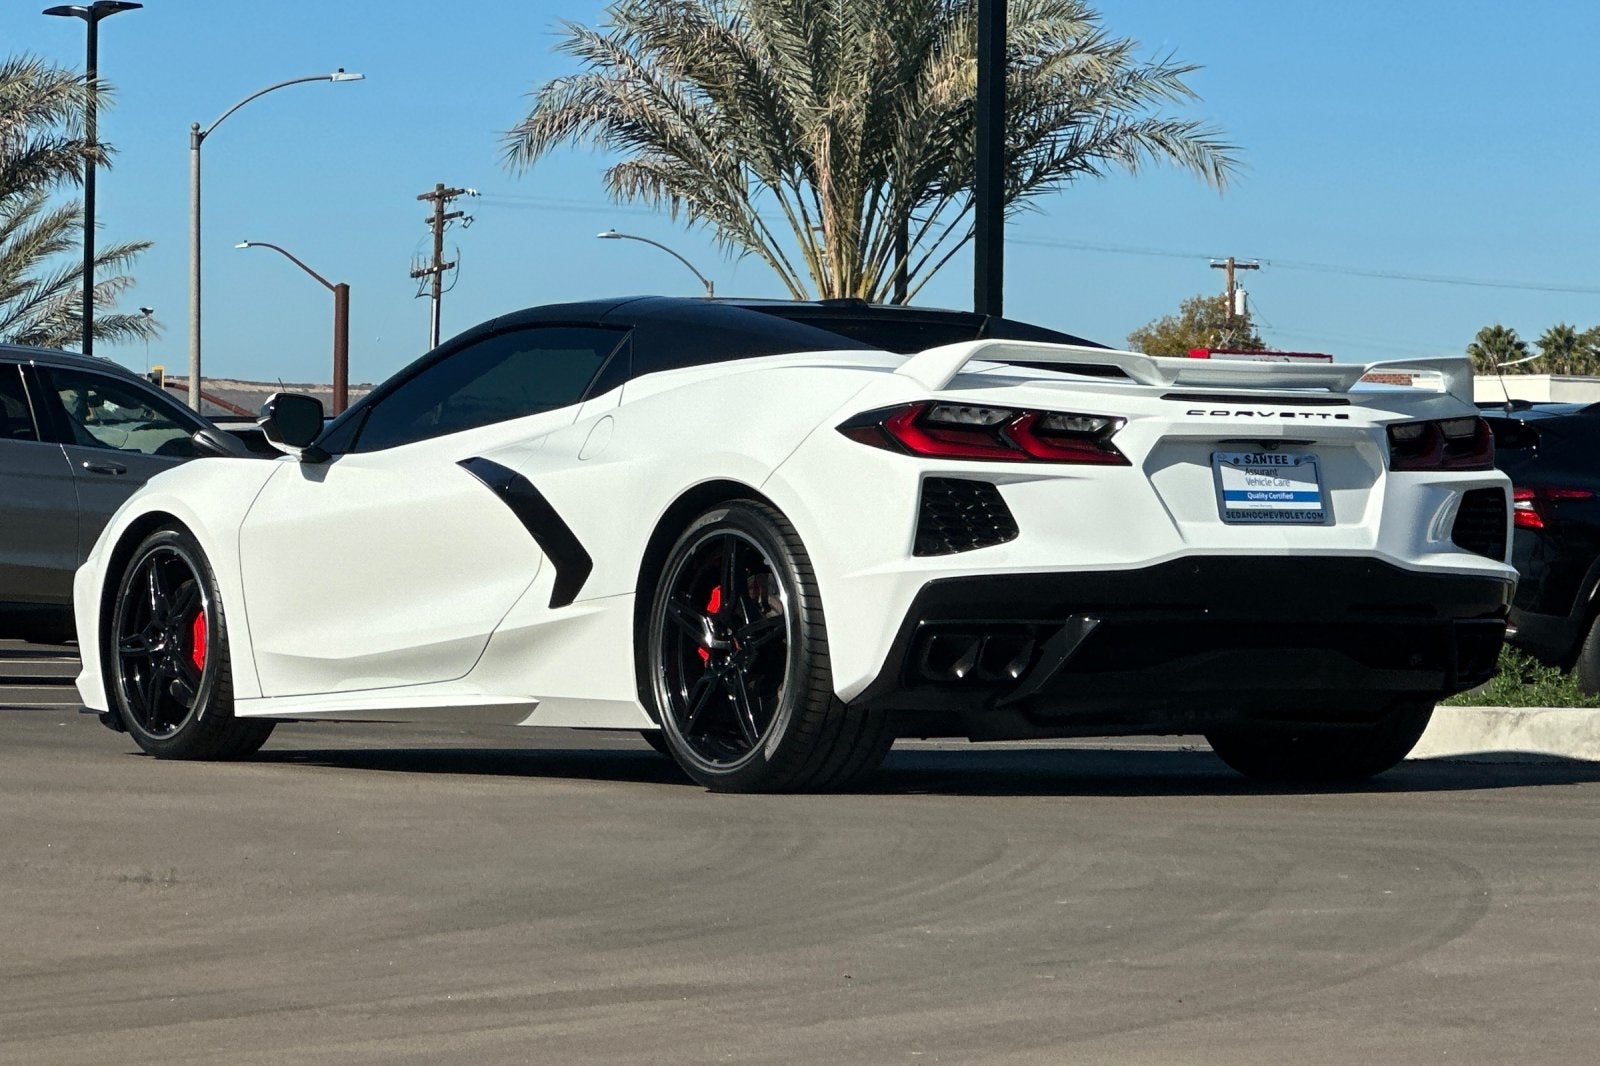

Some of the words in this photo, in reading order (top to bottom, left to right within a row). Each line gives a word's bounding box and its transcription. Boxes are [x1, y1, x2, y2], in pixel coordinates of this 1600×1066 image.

[1186, 409, 1348, 420] CORVETTE
[1244, 454, 1288, 465] SANTEE
[1245, 468, 1278, 477] Assurant
[1246, 477, 1271, 486] Vehicle
[1274, 478, 1290, 487] Care
[1247, 492, 1268, 501] Quality
[1269, 492, 1293, 500] Certified
[1226, 511, 1324, 520] SEDANOCHEVROLET.COM
